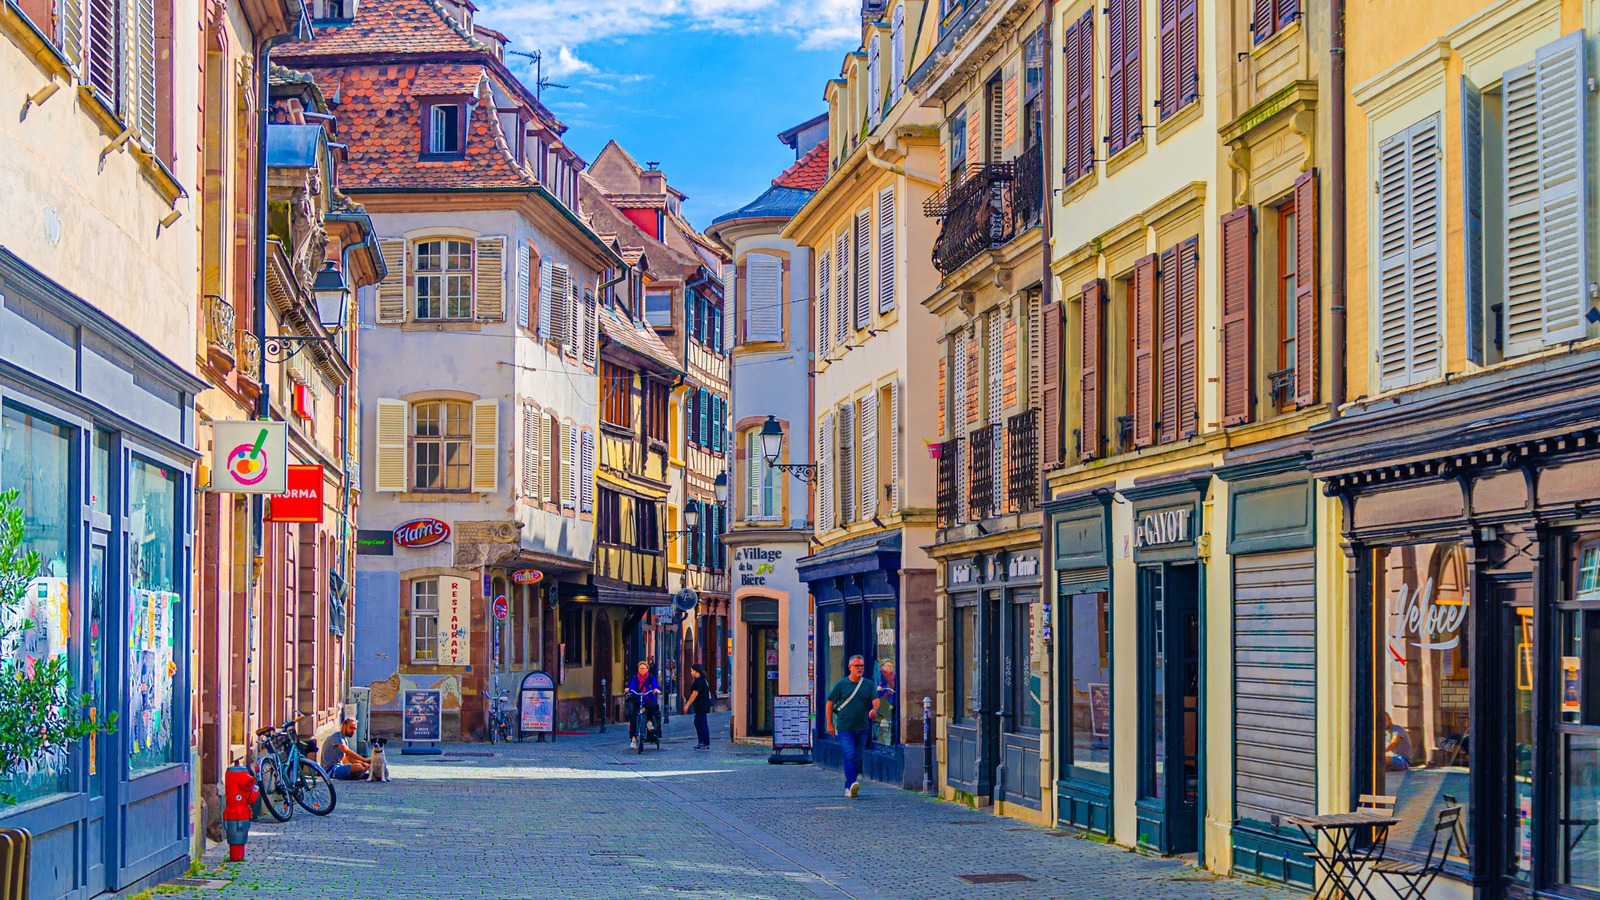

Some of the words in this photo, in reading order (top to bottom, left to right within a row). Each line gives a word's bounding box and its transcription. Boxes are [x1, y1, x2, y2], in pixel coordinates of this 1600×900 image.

[396, 520, 443, 544] Flam's
[1145, 509, 1186, 546] GAYOT
[743, 547, 782, 563] Village
[746, 562, 753, 571] la
[514, 570, 539, 582] Flam's
[741, 573, 765, 586] Bière
[1395, 576, 1467, 641] Veloce
